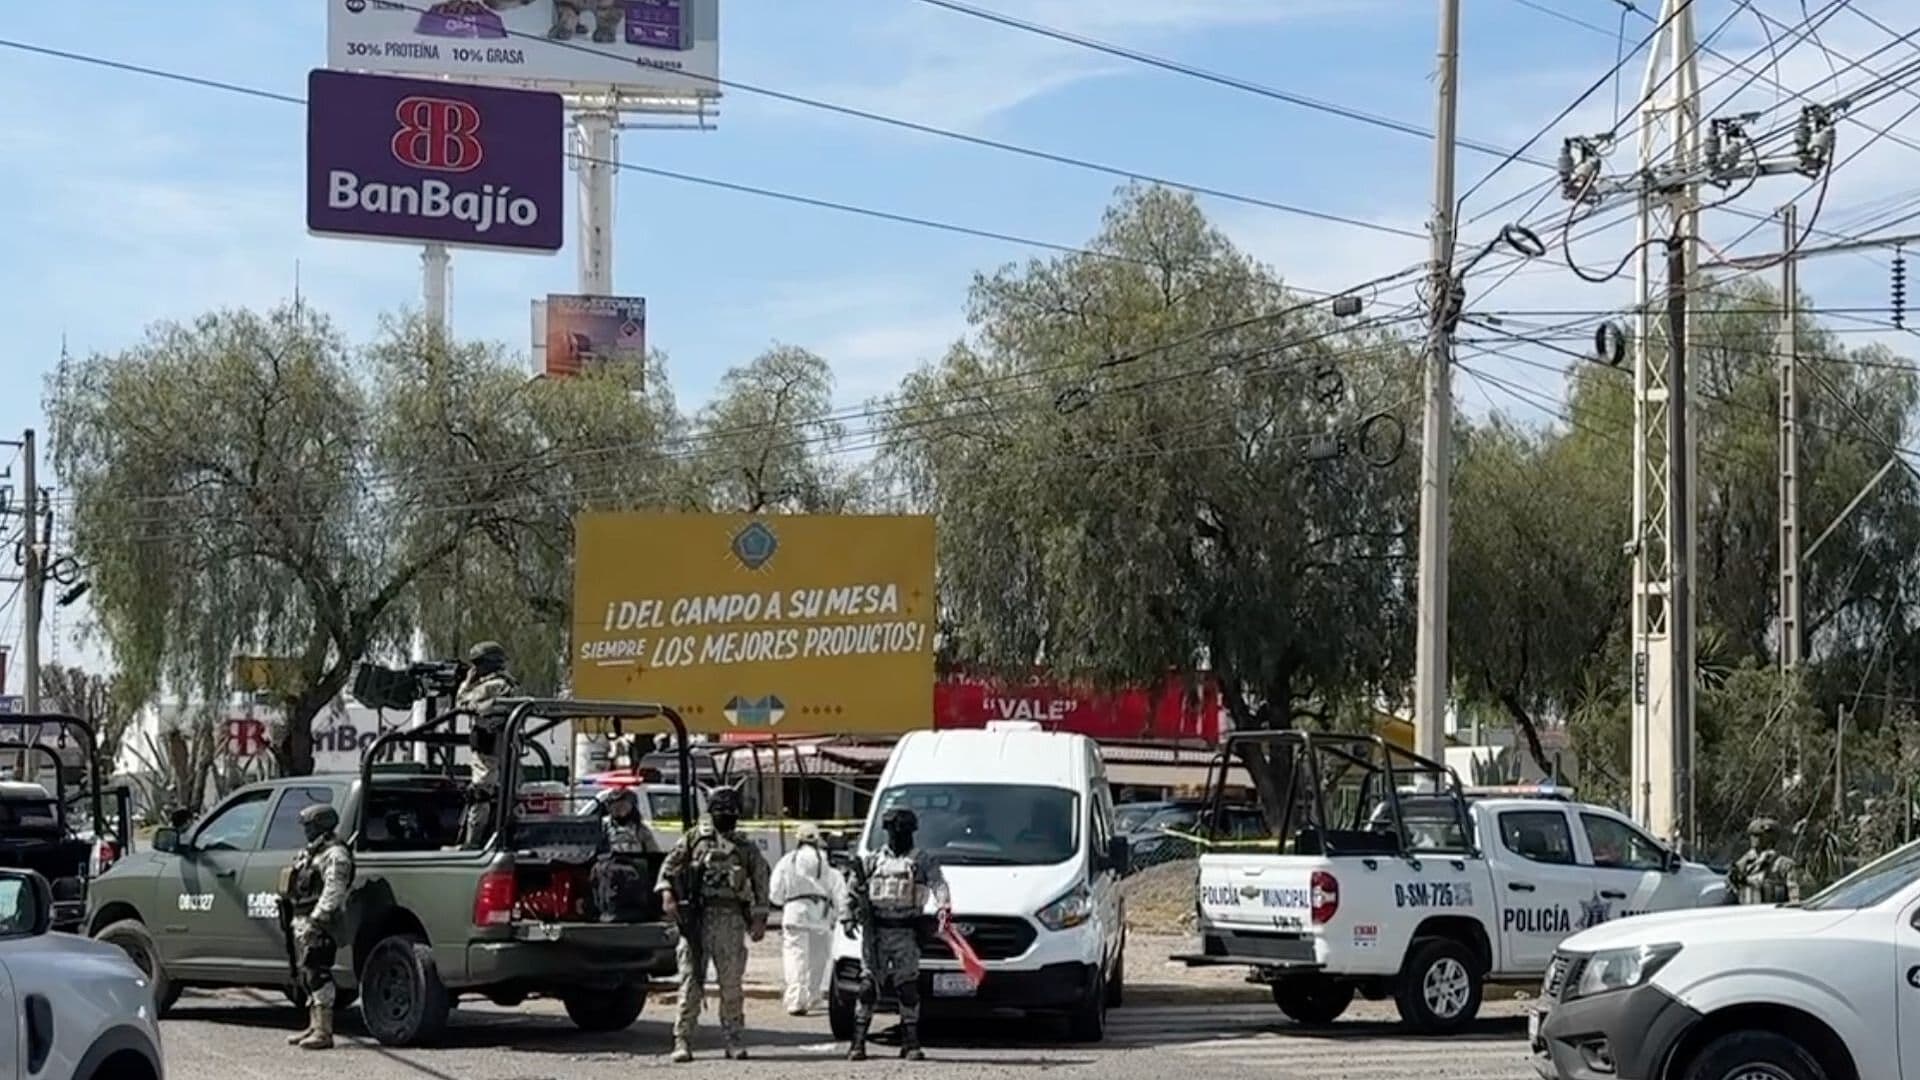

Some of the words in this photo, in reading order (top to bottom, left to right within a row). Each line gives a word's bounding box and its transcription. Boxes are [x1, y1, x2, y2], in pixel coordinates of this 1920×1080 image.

[346, 42, 382, 57] 30%
[385, 41, 439, 60] PROTEÍNA
[452, 48, 483, 62] 10%
[487, 49, 525, 64] GRASA
[328, 171, 538, 232] BanBajío
[670, 591, 761, 626] CAMPO
[763, 591, 782, 620] A
[787, 590, 820, 619] SU
[824, 583, 898, 616] MESA
[581, 638, 646, 660] SIEMPRE
[650, 637, 695, 668] LOS
[699, 629, 799, 665] MEJORES
[803, 621, 925, 657] PRODUCTOS!
[1203, 883, 1240, 906] POLICÍA
[1262, 888, 1309, 908] MUNICIPAL
[1503, 904, 1571, 932] POLICÍA
